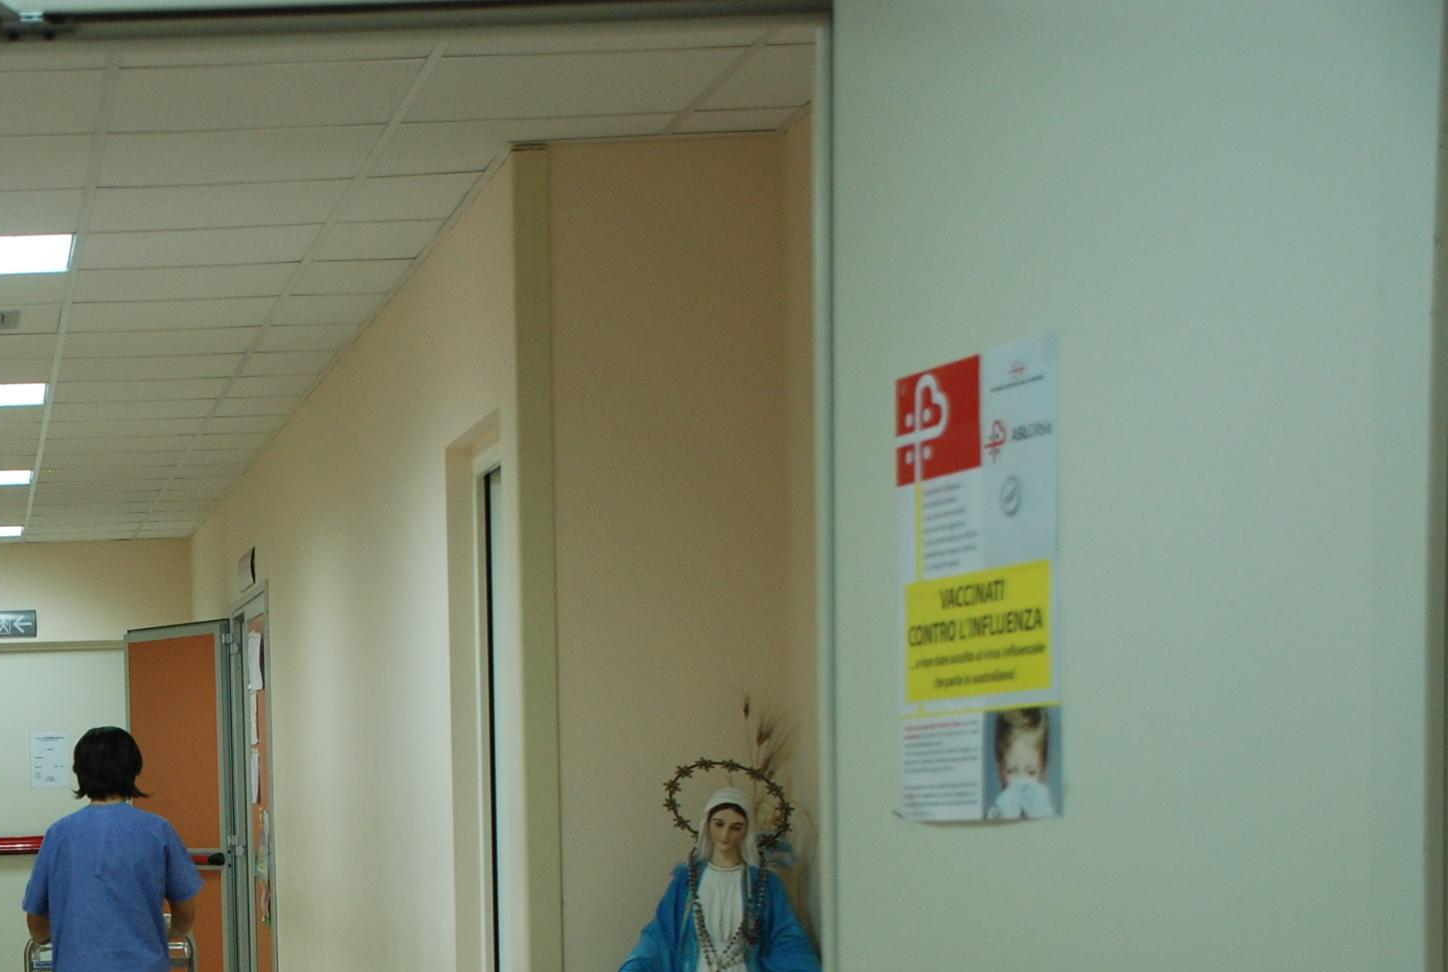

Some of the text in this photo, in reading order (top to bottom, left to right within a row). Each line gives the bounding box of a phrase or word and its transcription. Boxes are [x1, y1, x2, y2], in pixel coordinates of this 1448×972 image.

[939, 579, 1005, 610] VACCINATI
[908, 607, 1043, 647] CONTRO L'INFLUENZA
